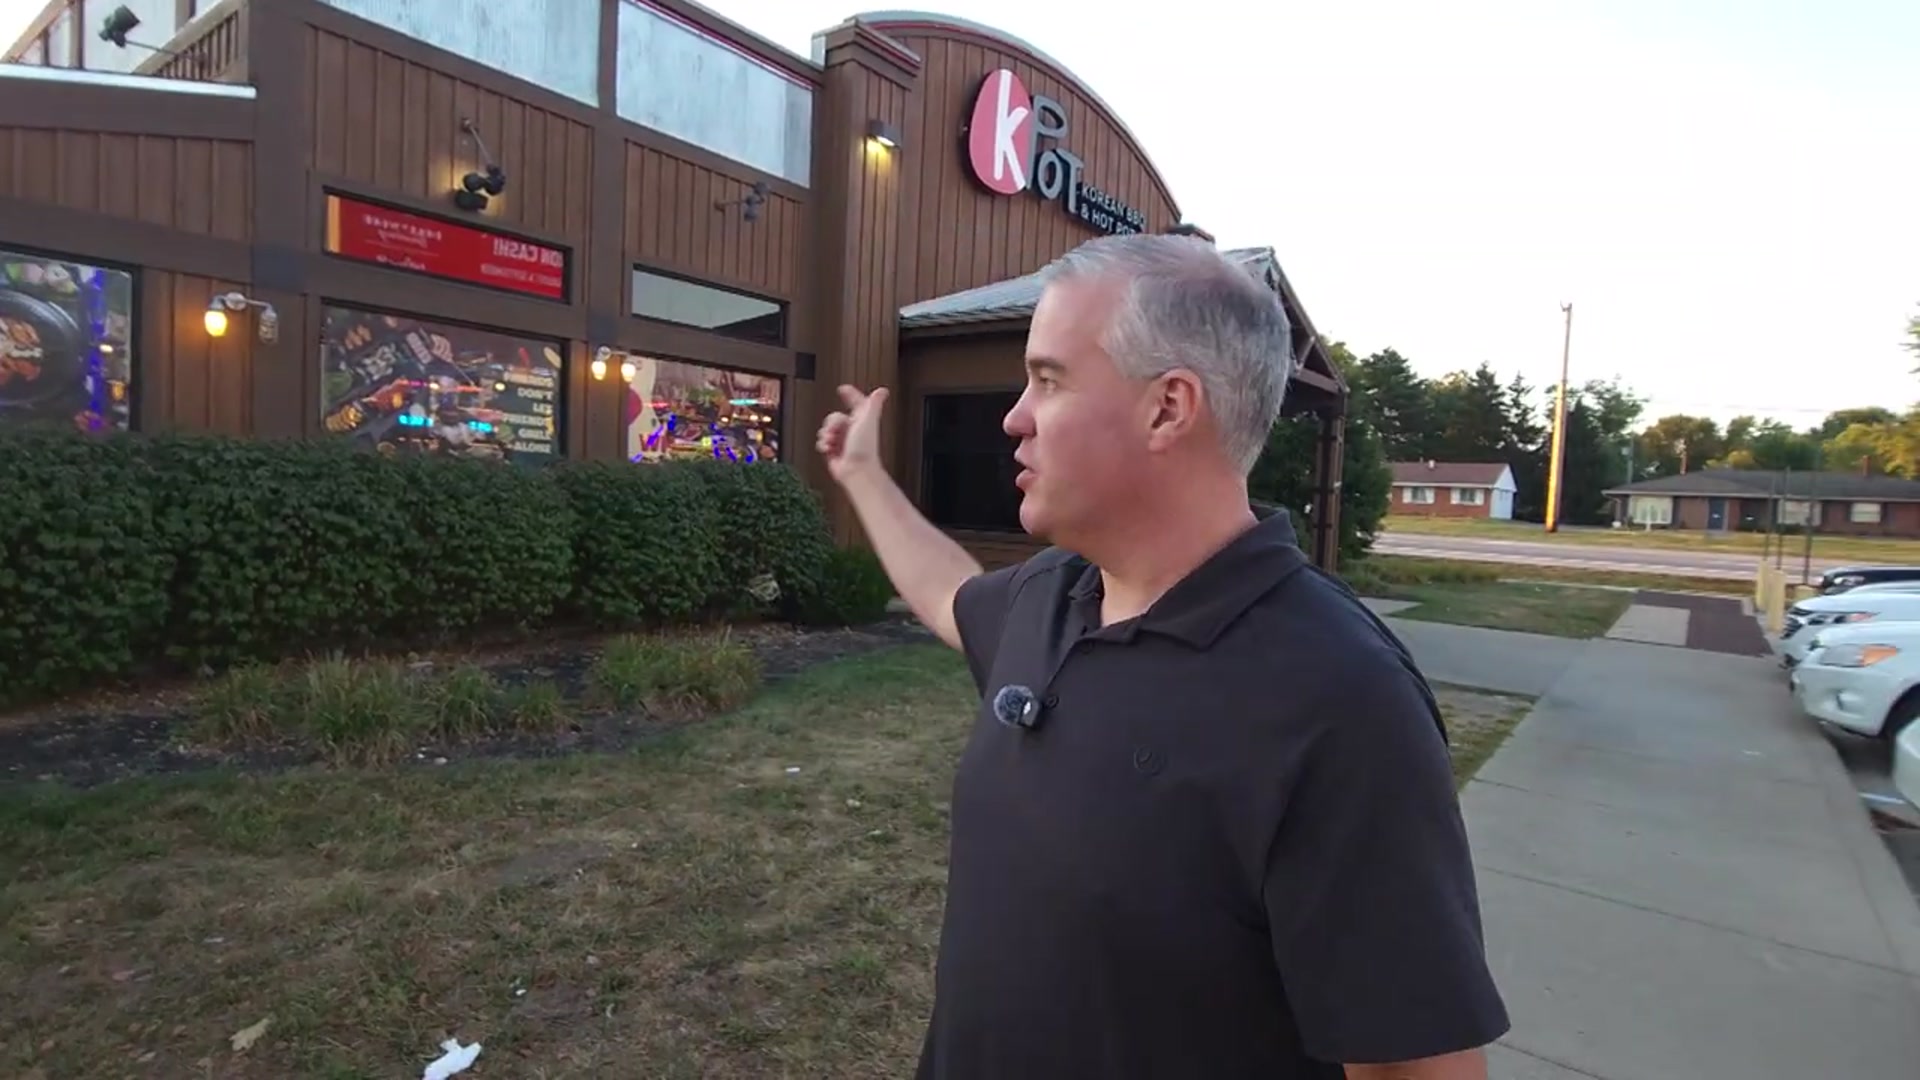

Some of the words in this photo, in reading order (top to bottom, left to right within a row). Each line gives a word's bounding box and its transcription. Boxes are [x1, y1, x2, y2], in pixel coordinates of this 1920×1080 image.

[1082, 184, 1124, 216] KOREAN
[1126, 208, 1146, 228] BBQ
[1081, 203, 1089, 220] &
[1092, 209, 1114, 232] HOT
[517, 387, 553, 400] DON'T
[503, 412, 553, 428] FRIEND
[513, 440, 551, 453] ALONE
